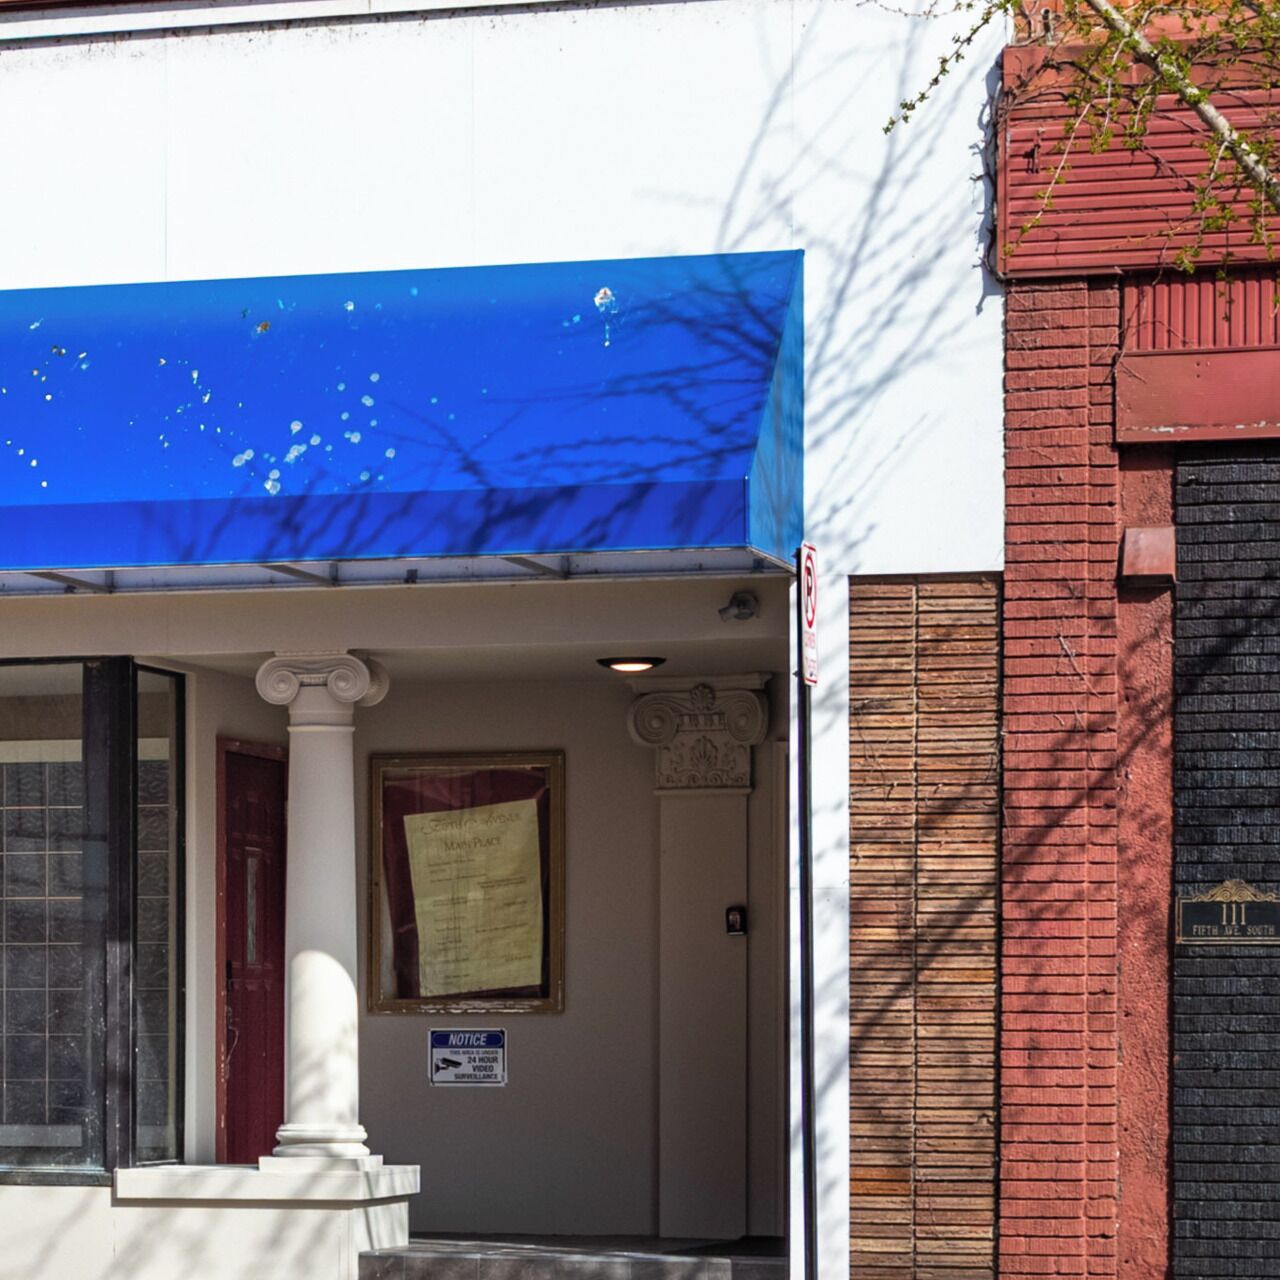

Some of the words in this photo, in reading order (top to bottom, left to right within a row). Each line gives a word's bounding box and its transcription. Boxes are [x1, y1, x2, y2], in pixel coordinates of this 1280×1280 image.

[1222, 904, 1246, 925] 111
[1192, 925, 1218, 936] FIFTH
[1246, 925, 1275, 936] SOUTH
[448, 1033, 487, 1046] NOTICE
[467, 1056, 476, 1064] 24
[478, 1056, 498, 1064] HOUR
[472, 1065, 494, 1073] VIDEO
